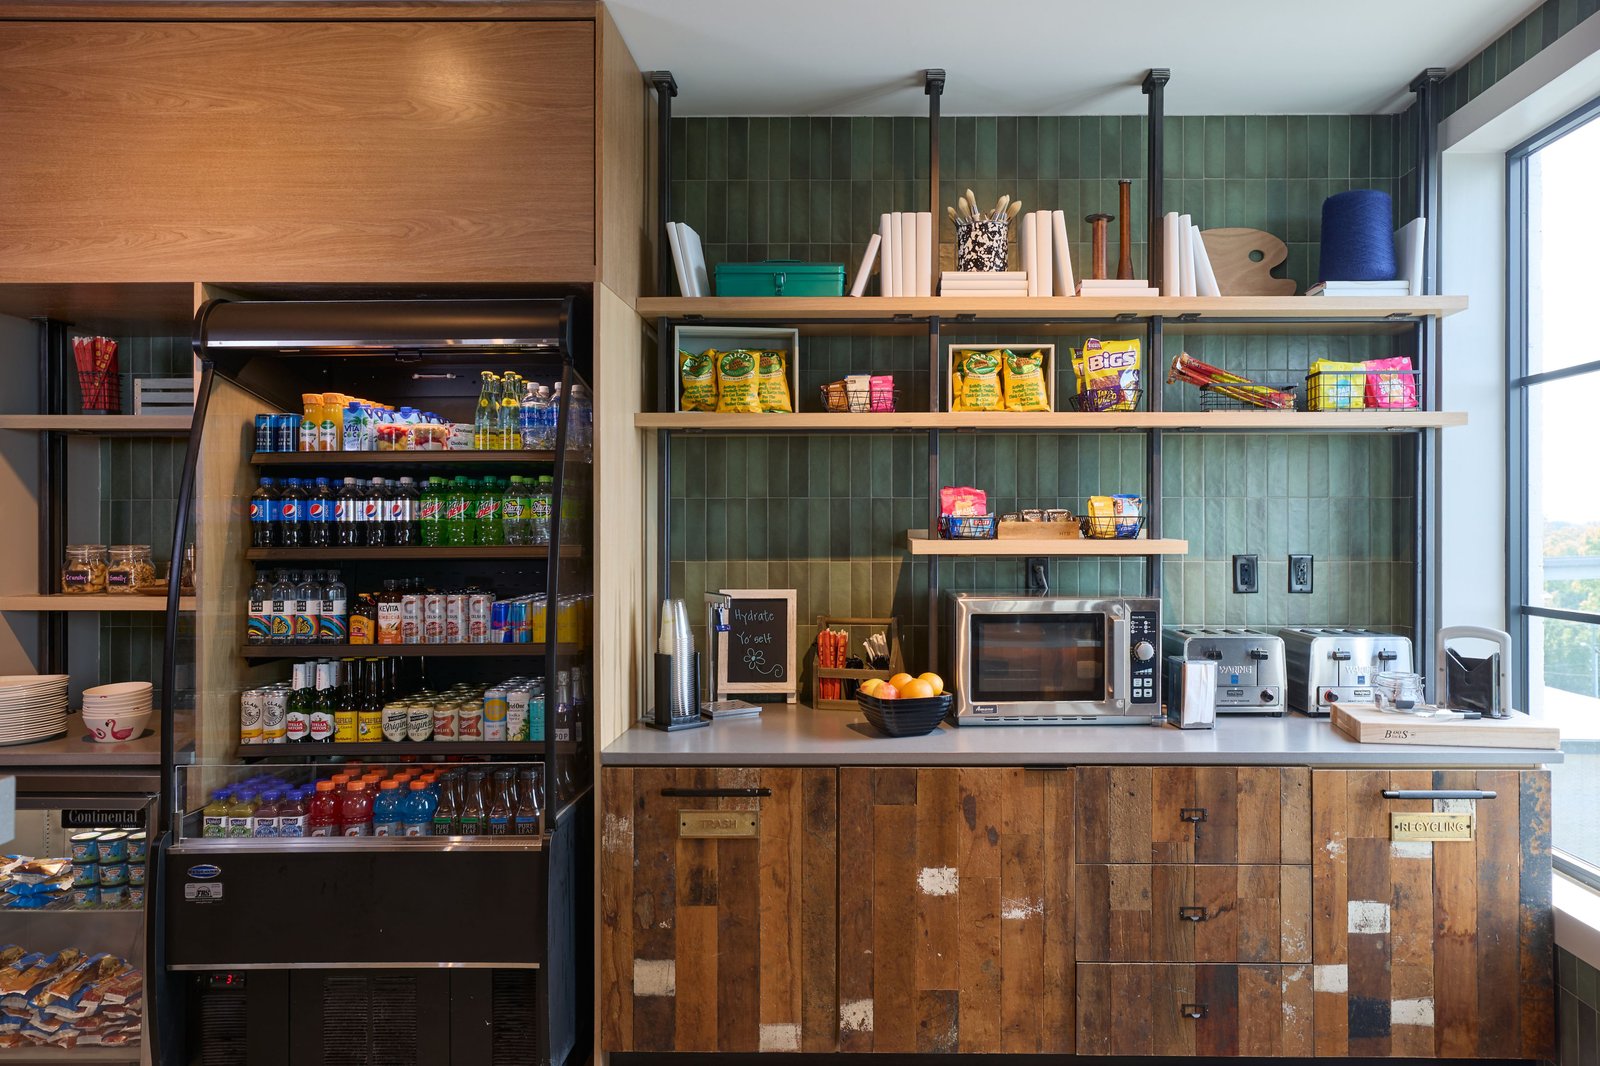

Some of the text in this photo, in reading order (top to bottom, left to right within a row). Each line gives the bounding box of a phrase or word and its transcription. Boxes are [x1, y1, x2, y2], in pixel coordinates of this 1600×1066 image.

[1089, 351, 1136, 372] BiGS
[344, 424, 360, 432] VITA
[734, 608, 775, 625] Hydrate
[754, 632, 772, 643] self
[1219, 665, 1252, 674] WARING
[69, 811, 137, 823] Continental
[1400, 822, 1464, 832] RECYCLING
